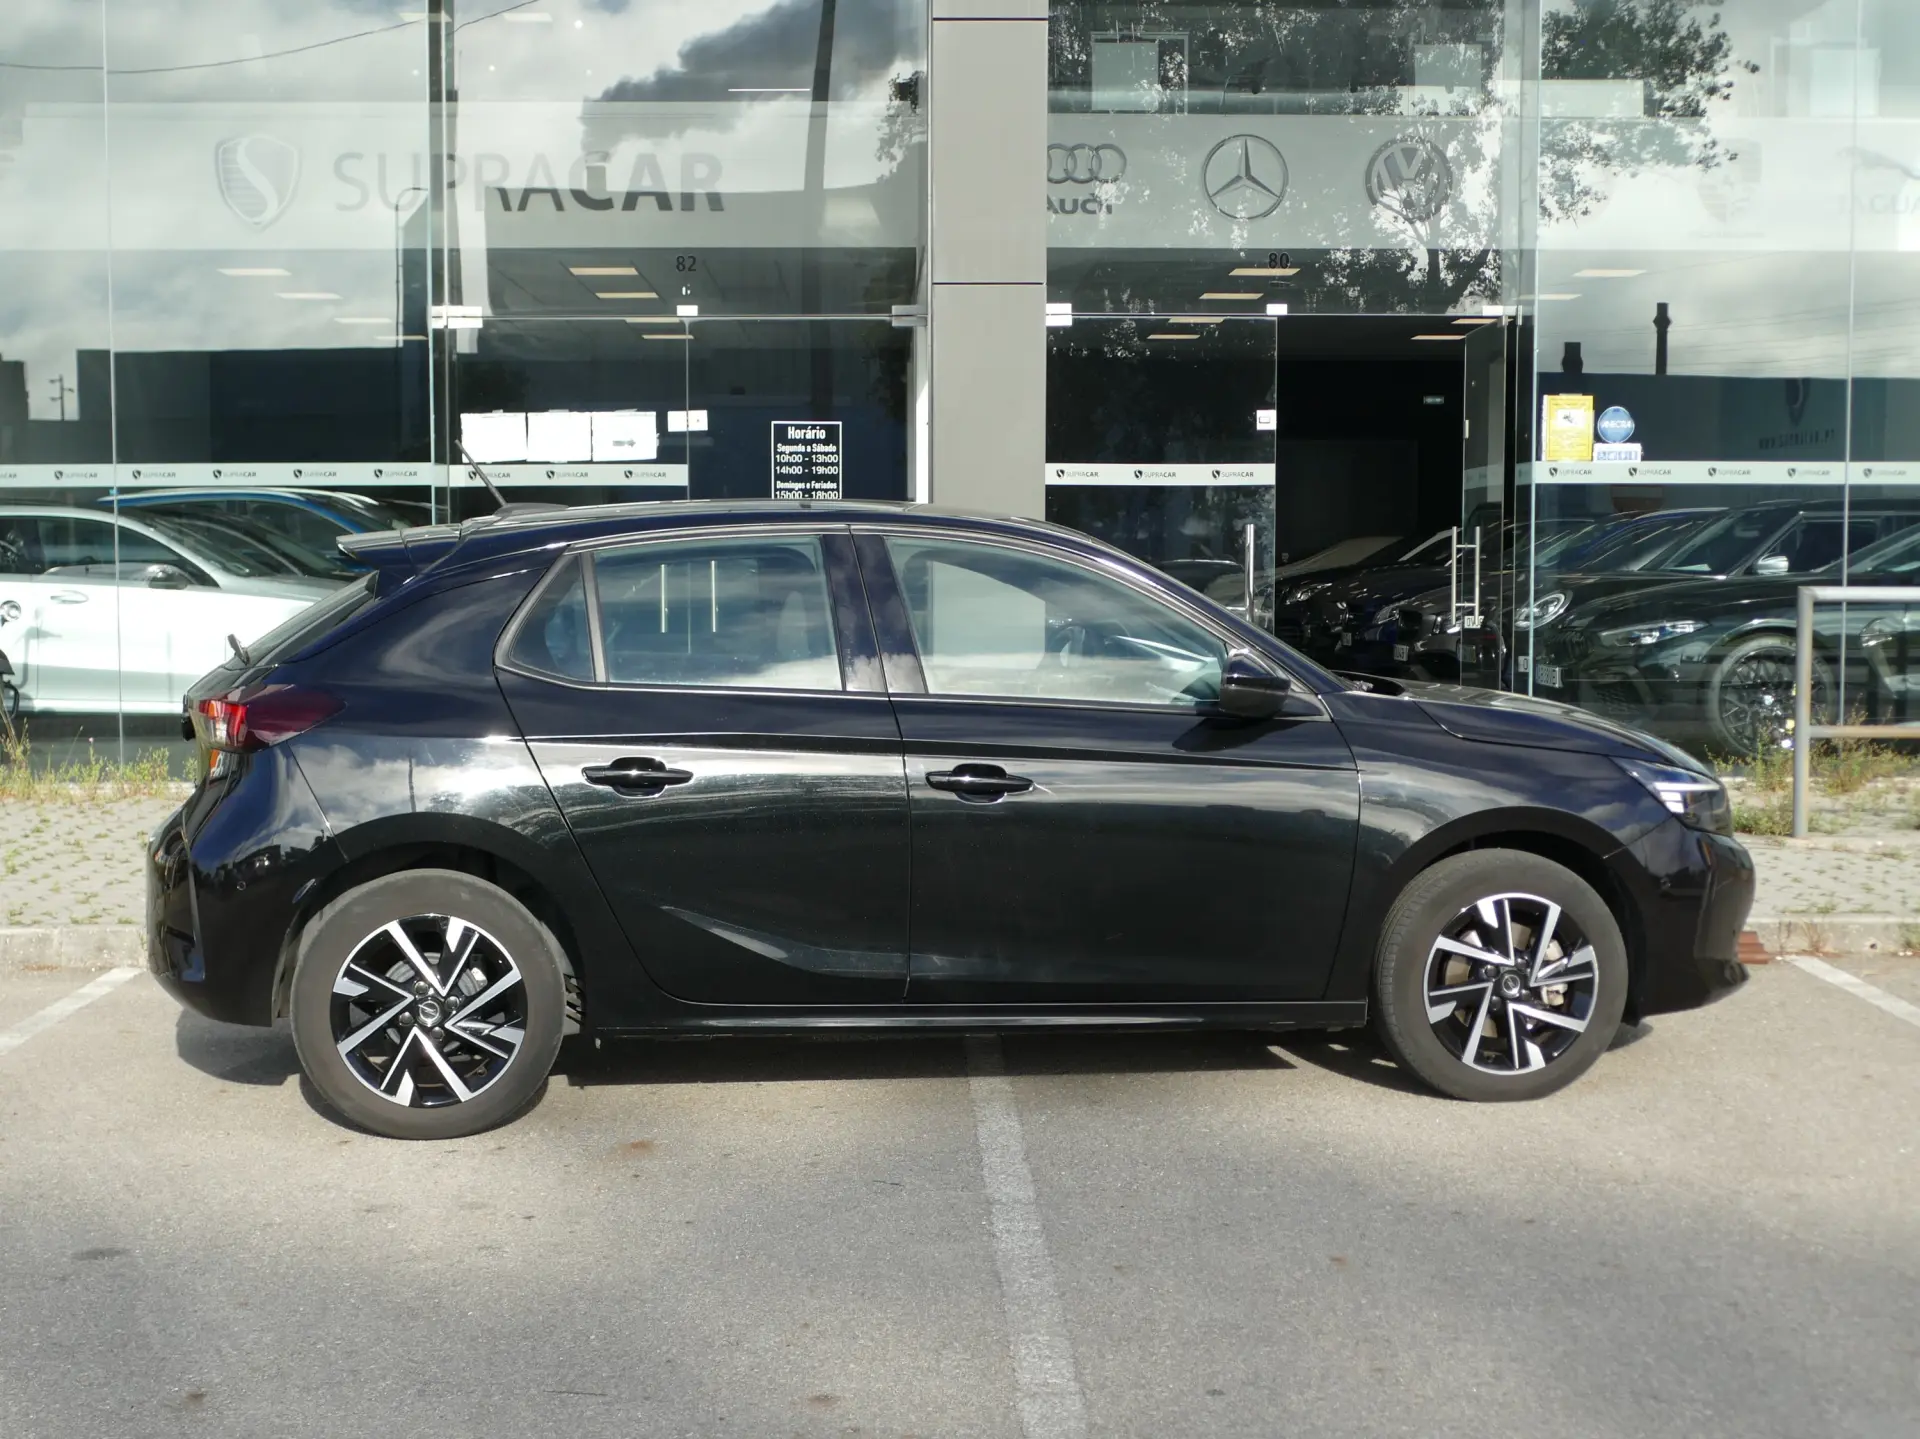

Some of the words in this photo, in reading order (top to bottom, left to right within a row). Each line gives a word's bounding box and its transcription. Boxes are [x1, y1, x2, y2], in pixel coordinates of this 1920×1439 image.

[333, 151, 725, 212] SUPRACAR
[676, 255, 697, 272] 82
[1268, 252, 1290, 269] 80
[787, 426, 826, 440] Horário
[777, 443, 806, 454] Segunda
[812, 443, 837, 453] Sábado
[775, 454, 803, 463] 10h00
[811, 454, 839, 463] 13h00
[775, 466, 803, 475] 14h00
[811, 466, 839, 475] 19h00
[775, 491, 803, 500] 15h00
[811, 491, 839, 500] 18h00
